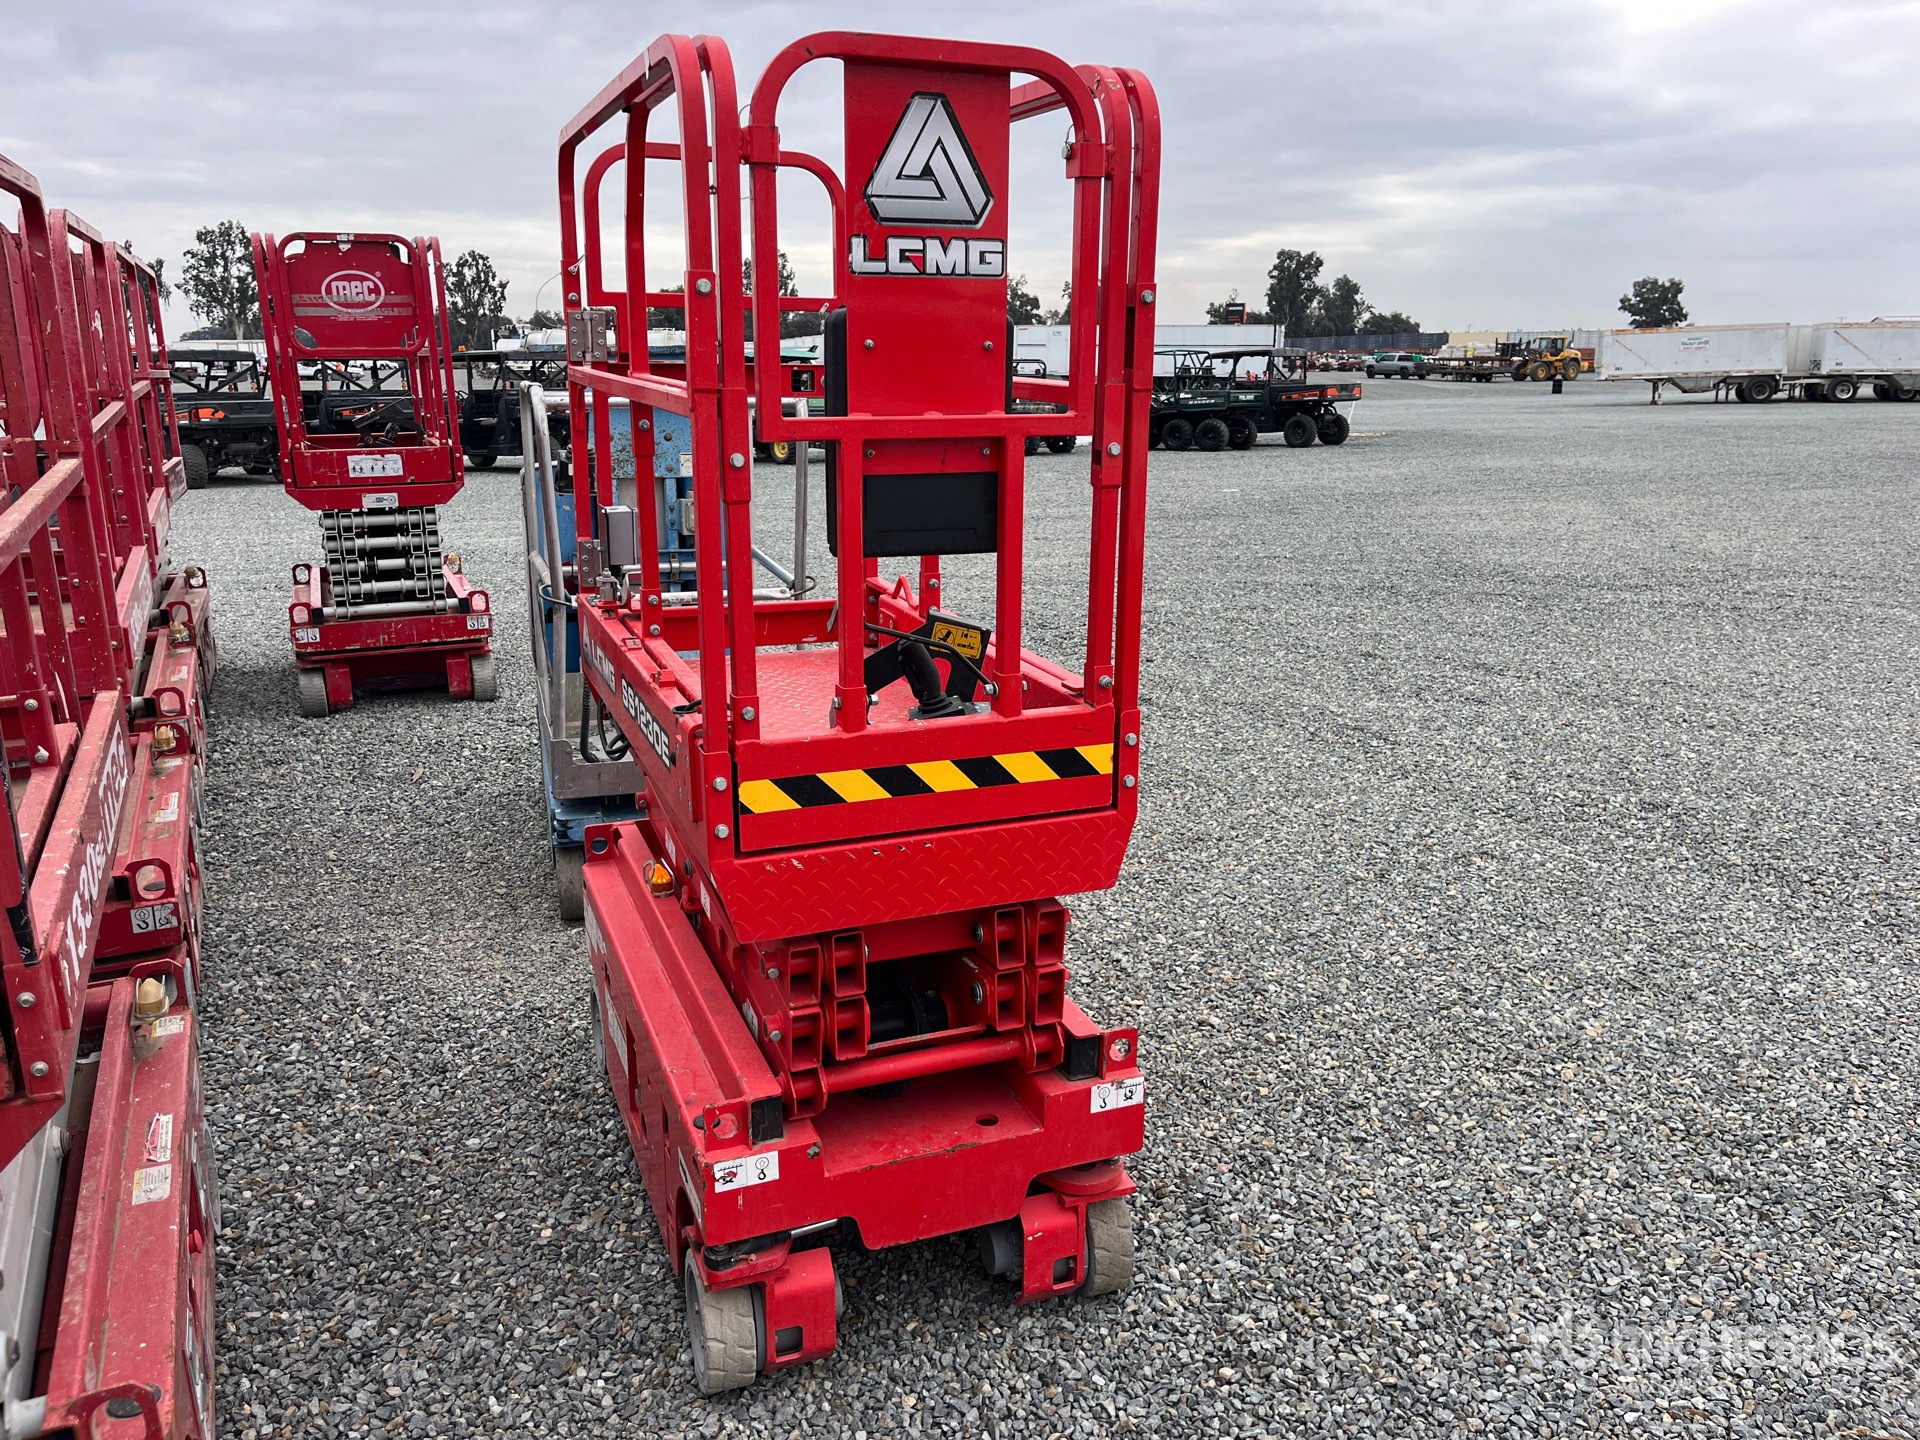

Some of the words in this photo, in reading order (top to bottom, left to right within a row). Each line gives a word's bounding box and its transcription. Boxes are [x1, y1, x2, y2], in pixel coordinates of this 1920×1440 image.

[850, 235, 1006, 278] LGMG
[591, 639, 616, 695] LGMG
[621, 675, 671, 771] SS1230E
